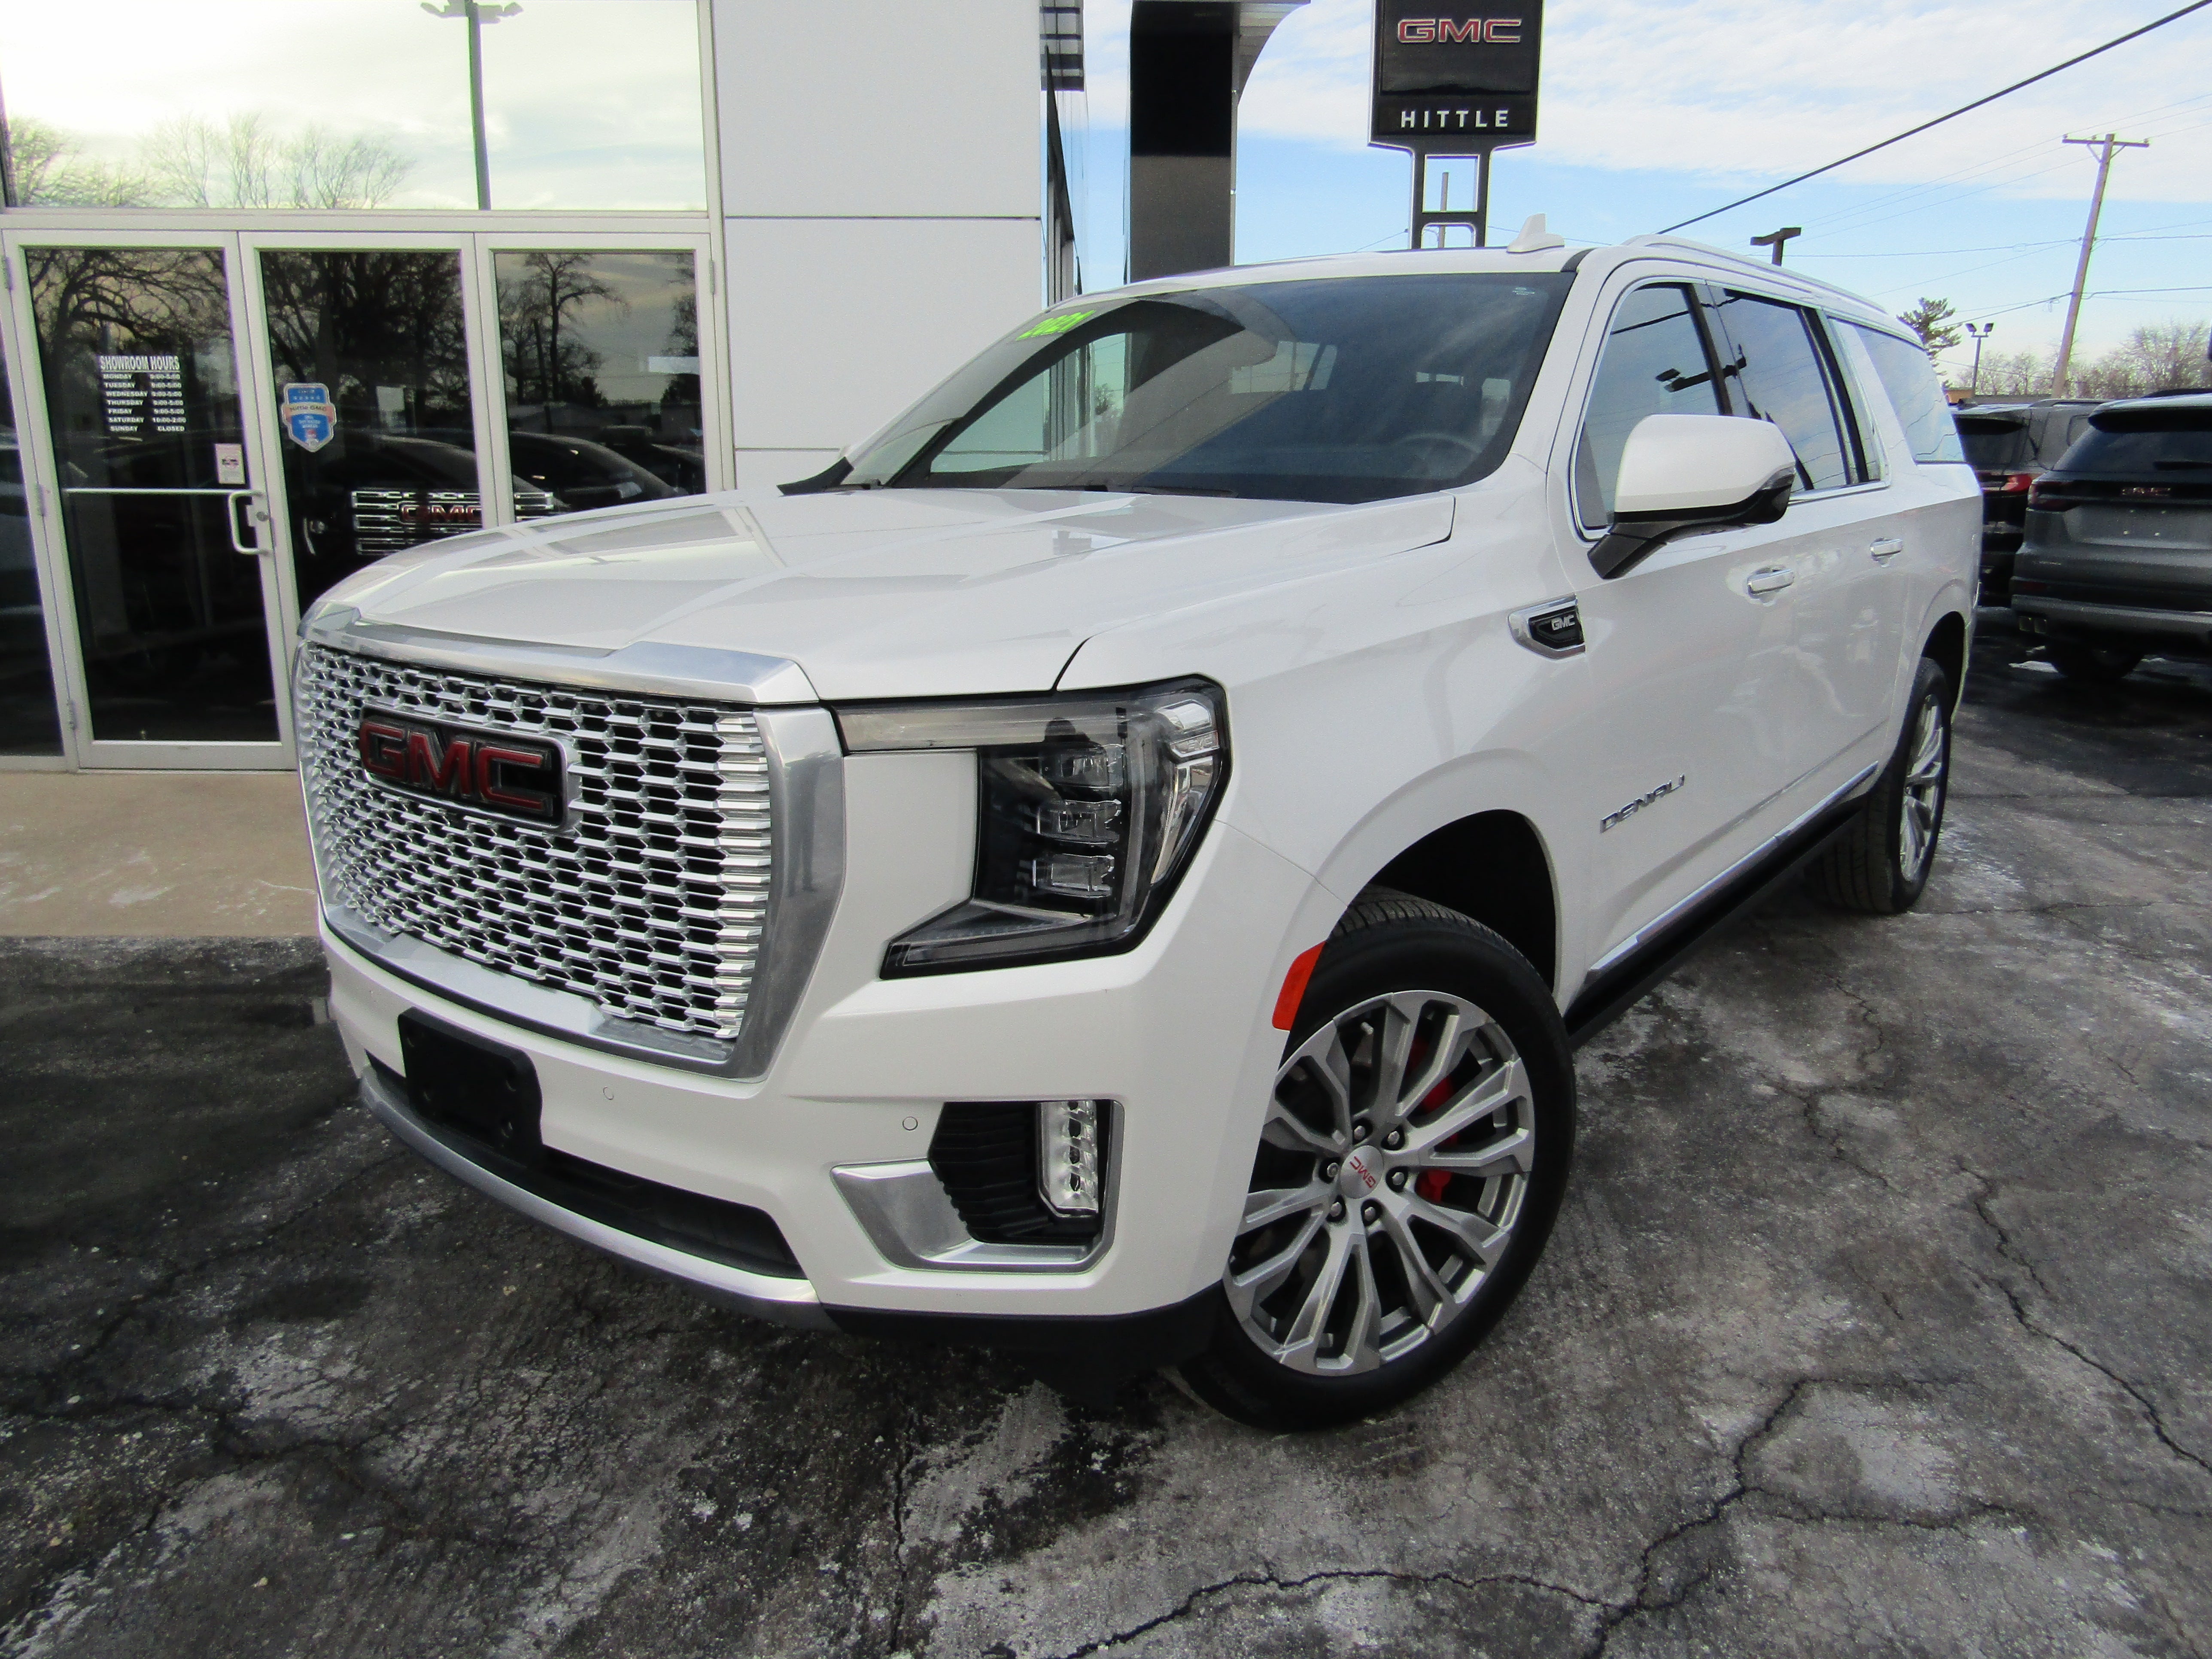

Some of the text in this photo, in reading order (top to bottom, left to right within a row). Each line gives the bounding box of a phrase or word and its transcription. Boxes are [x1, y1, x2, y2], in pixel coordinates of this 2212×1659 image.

[1398, 18, 1522, 43] GMC
[1401, 110, 1509, 128] HITTLE
[100, 355, 180, 370] SHOWROOM HOURS
[1551, 614, 1575, 631] GMC
[359, 720, 553, 816] GMC
[1599, 773, 1685, 833] DENALI
[1349, 1156, 1376, 1188] GMC
